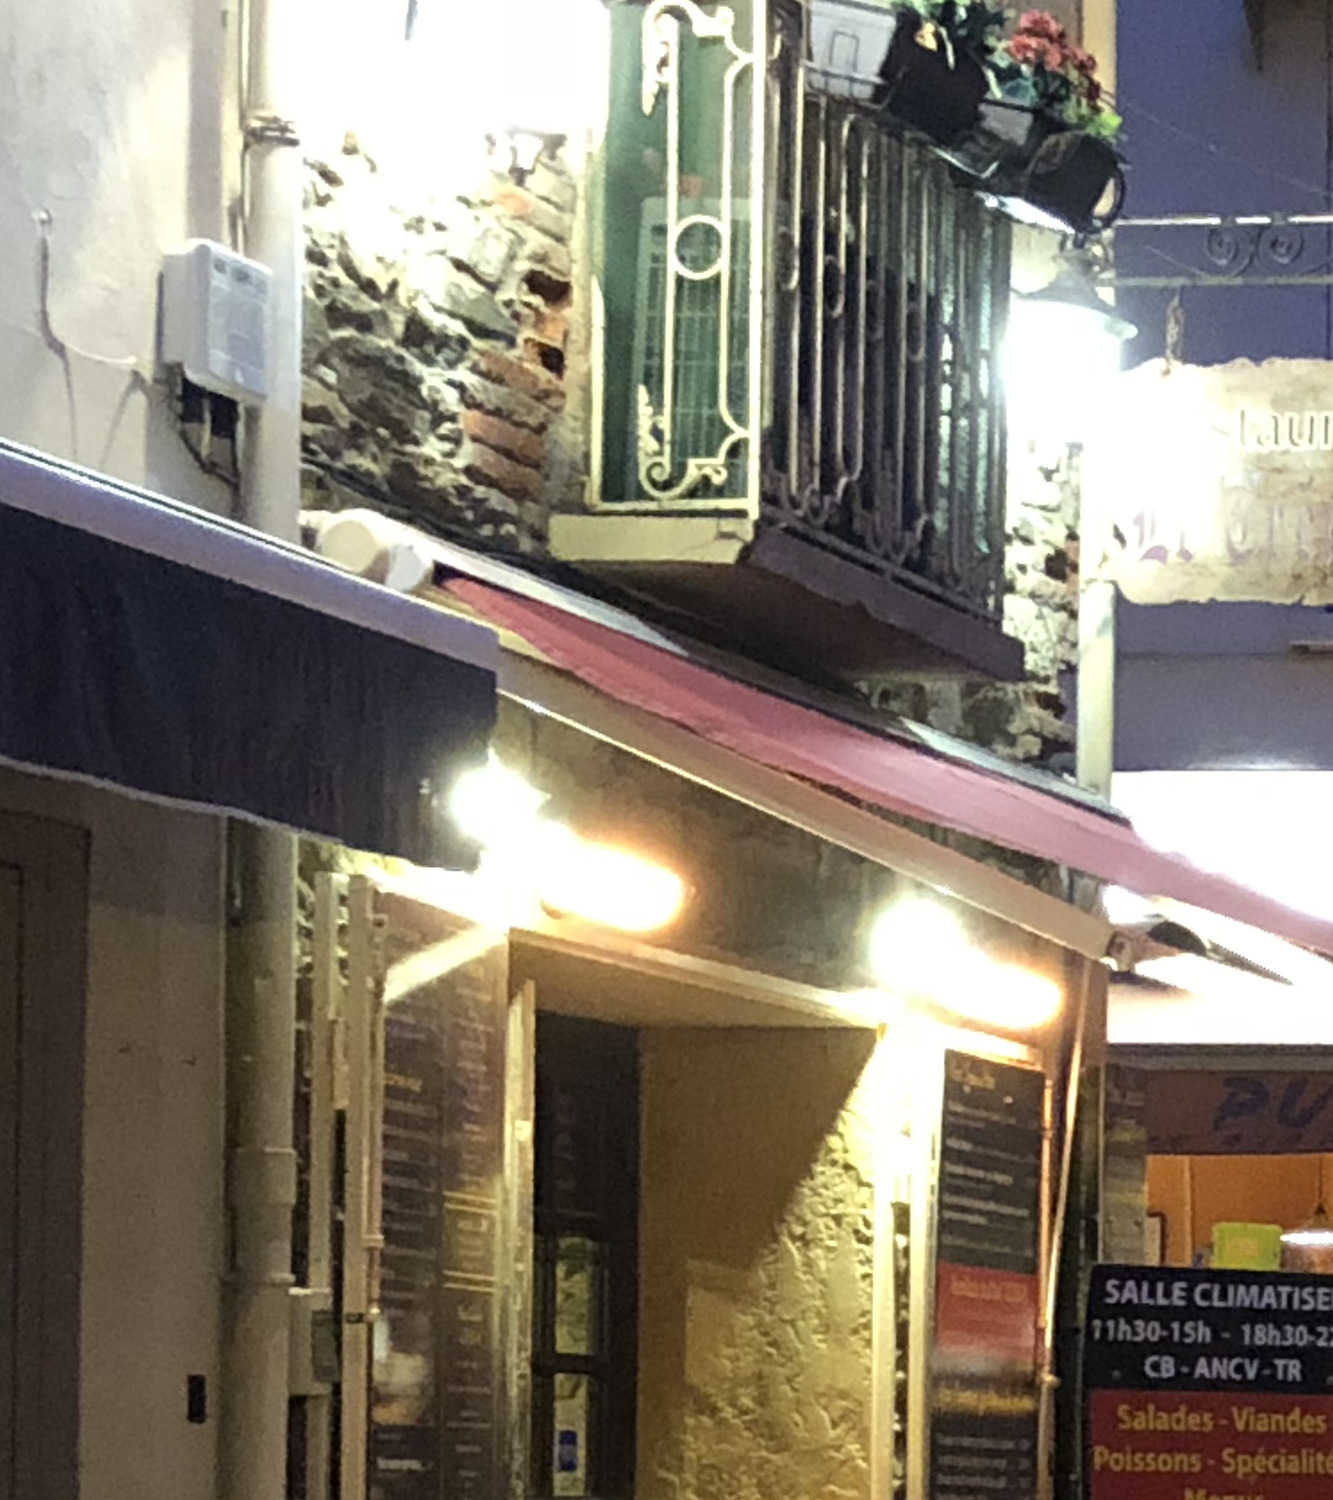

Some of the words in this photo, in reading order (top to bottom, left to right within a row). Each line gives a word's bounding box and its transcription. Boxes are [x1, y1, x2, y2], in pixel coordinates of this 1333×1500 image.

[1104, 1278, 1187, 1306] SALLE
[1144, 1355, 1176, 1379] CB
[1194, 1357, 1259, 1380] ANCV
[1274, 1359, 1302, 1382] TR
[1116, 1404, 1213, 1432] Salades
[1231, 1406, 1328, 1433] Viandes
[1093, 1445, 1202, 1473] Poissons
